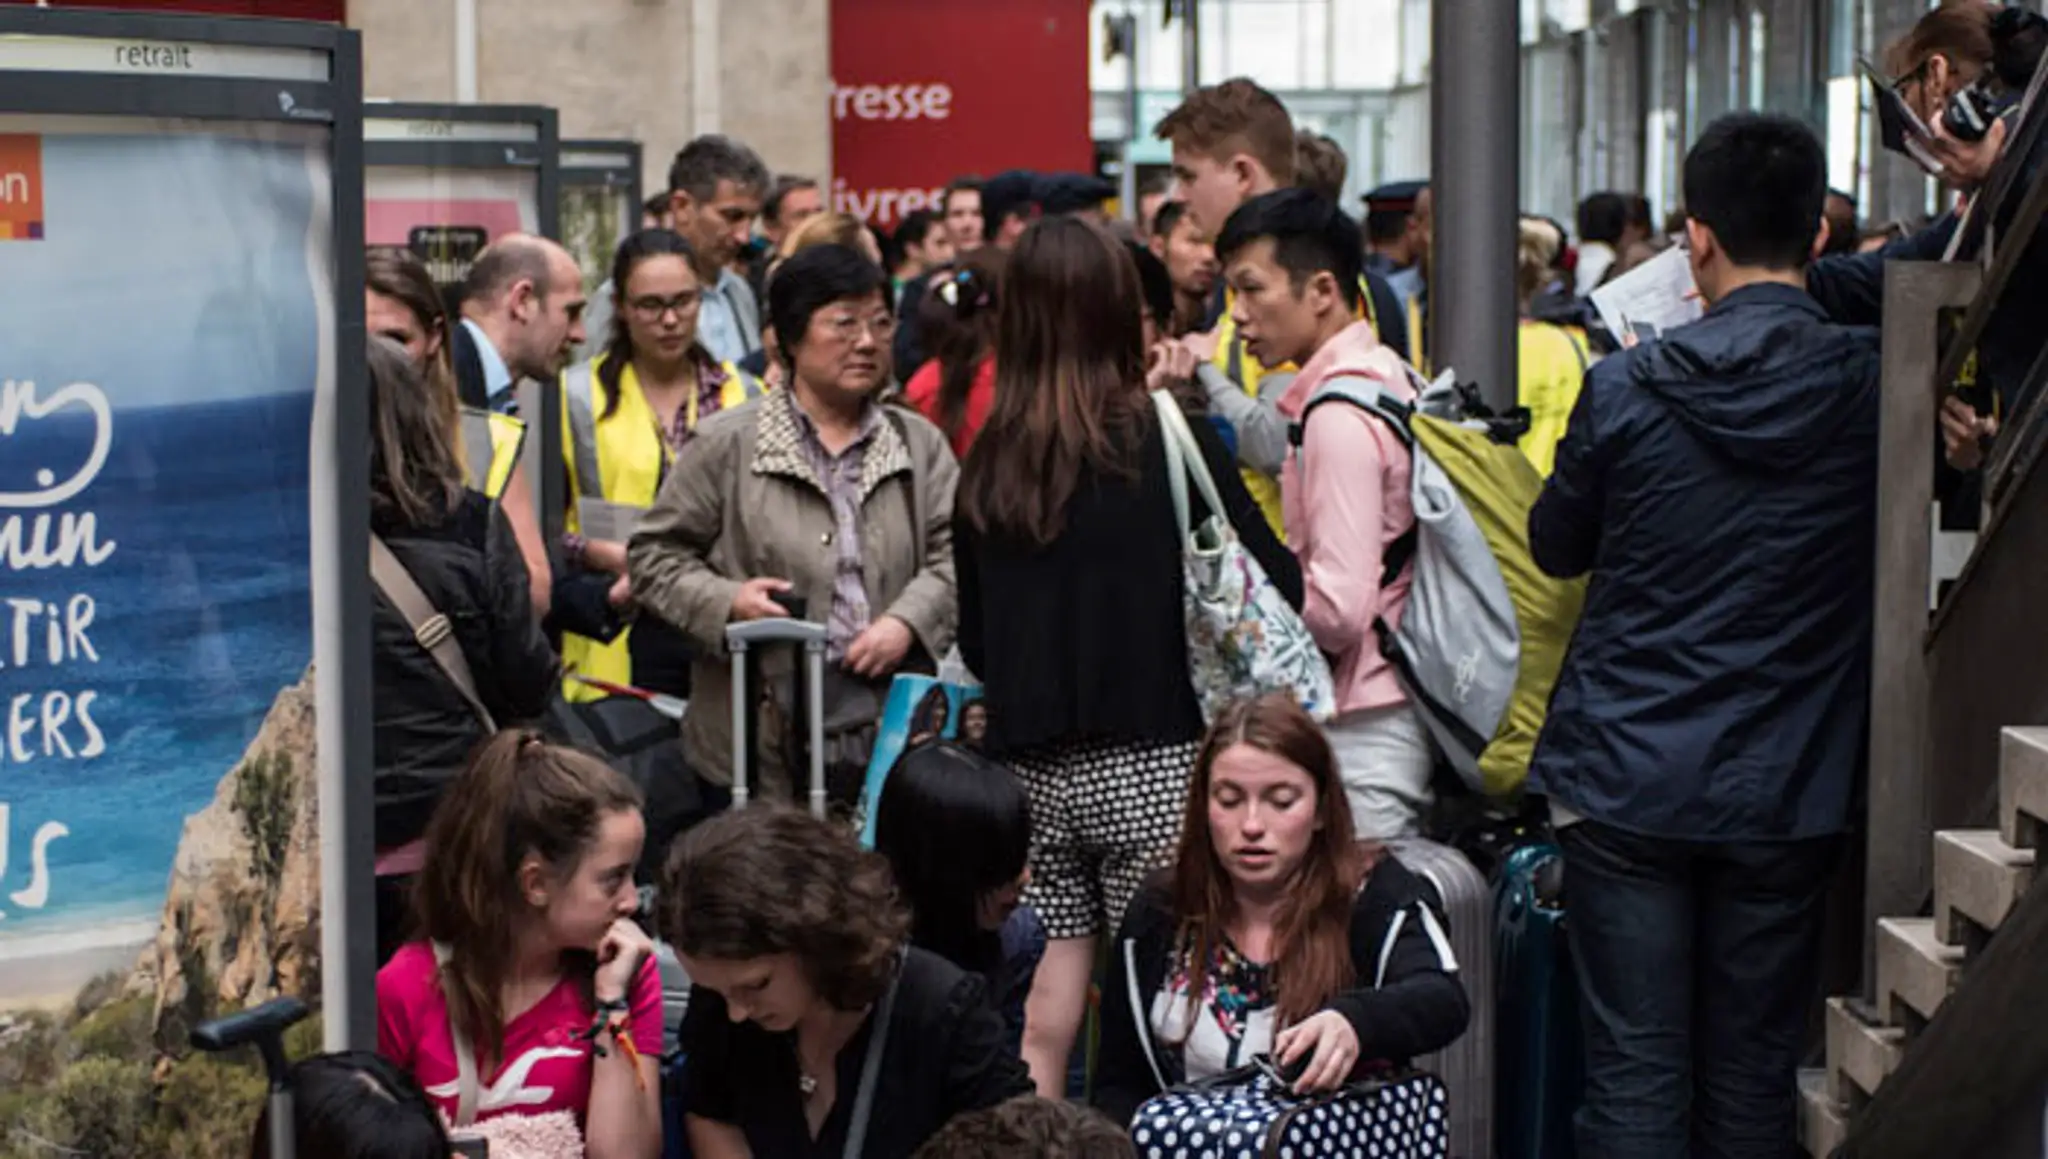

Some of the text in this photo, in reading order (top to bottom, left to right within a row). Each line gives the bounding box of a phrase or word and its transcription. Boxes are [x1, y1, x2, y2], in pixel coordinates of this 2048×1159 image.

[115, 44, 193, 69] retrait
[830, 82, 953, 120] resse
[0, 593, 100, 667] TIR
[0, 690, 106, 763] ERS
